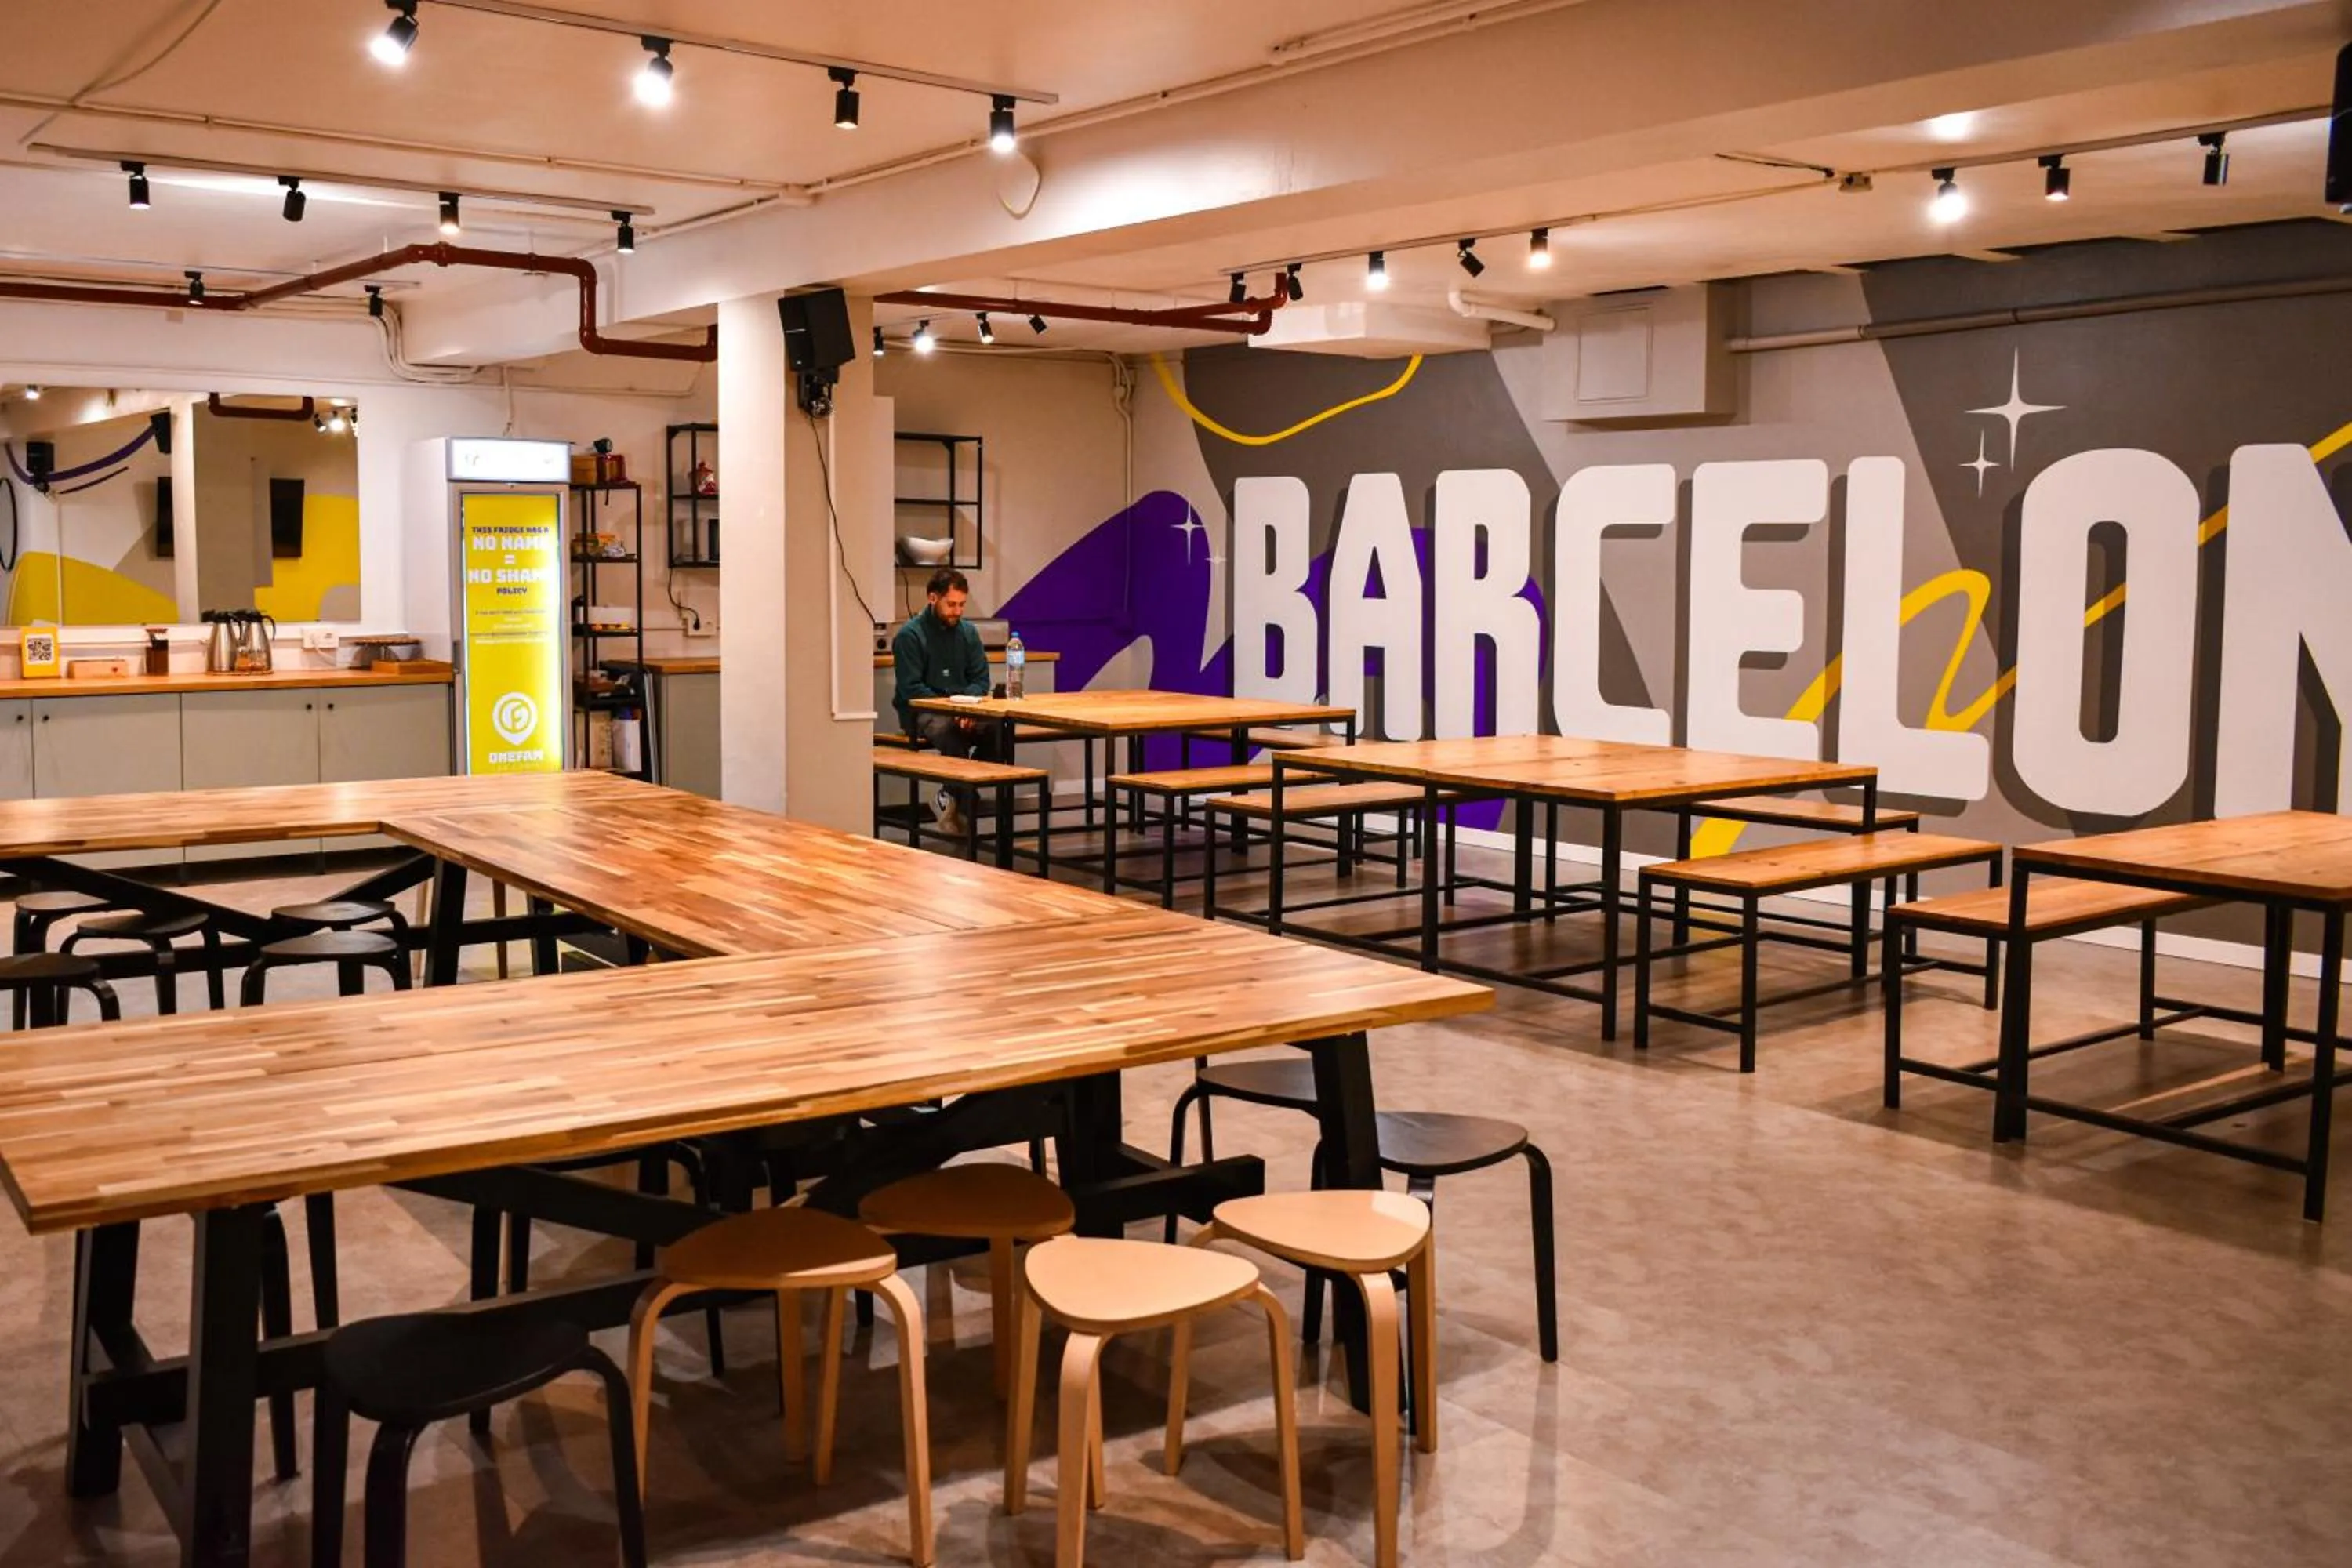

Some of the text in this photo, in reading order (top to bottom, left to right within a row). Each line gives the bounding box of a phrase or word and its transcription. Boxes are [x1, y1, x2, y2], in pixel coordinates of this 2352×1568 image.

[473, 535, 496, 550] NO
[468, 568, 554, 584] NO SHAM
[1233, 442, 2352, 820] BARCELON
